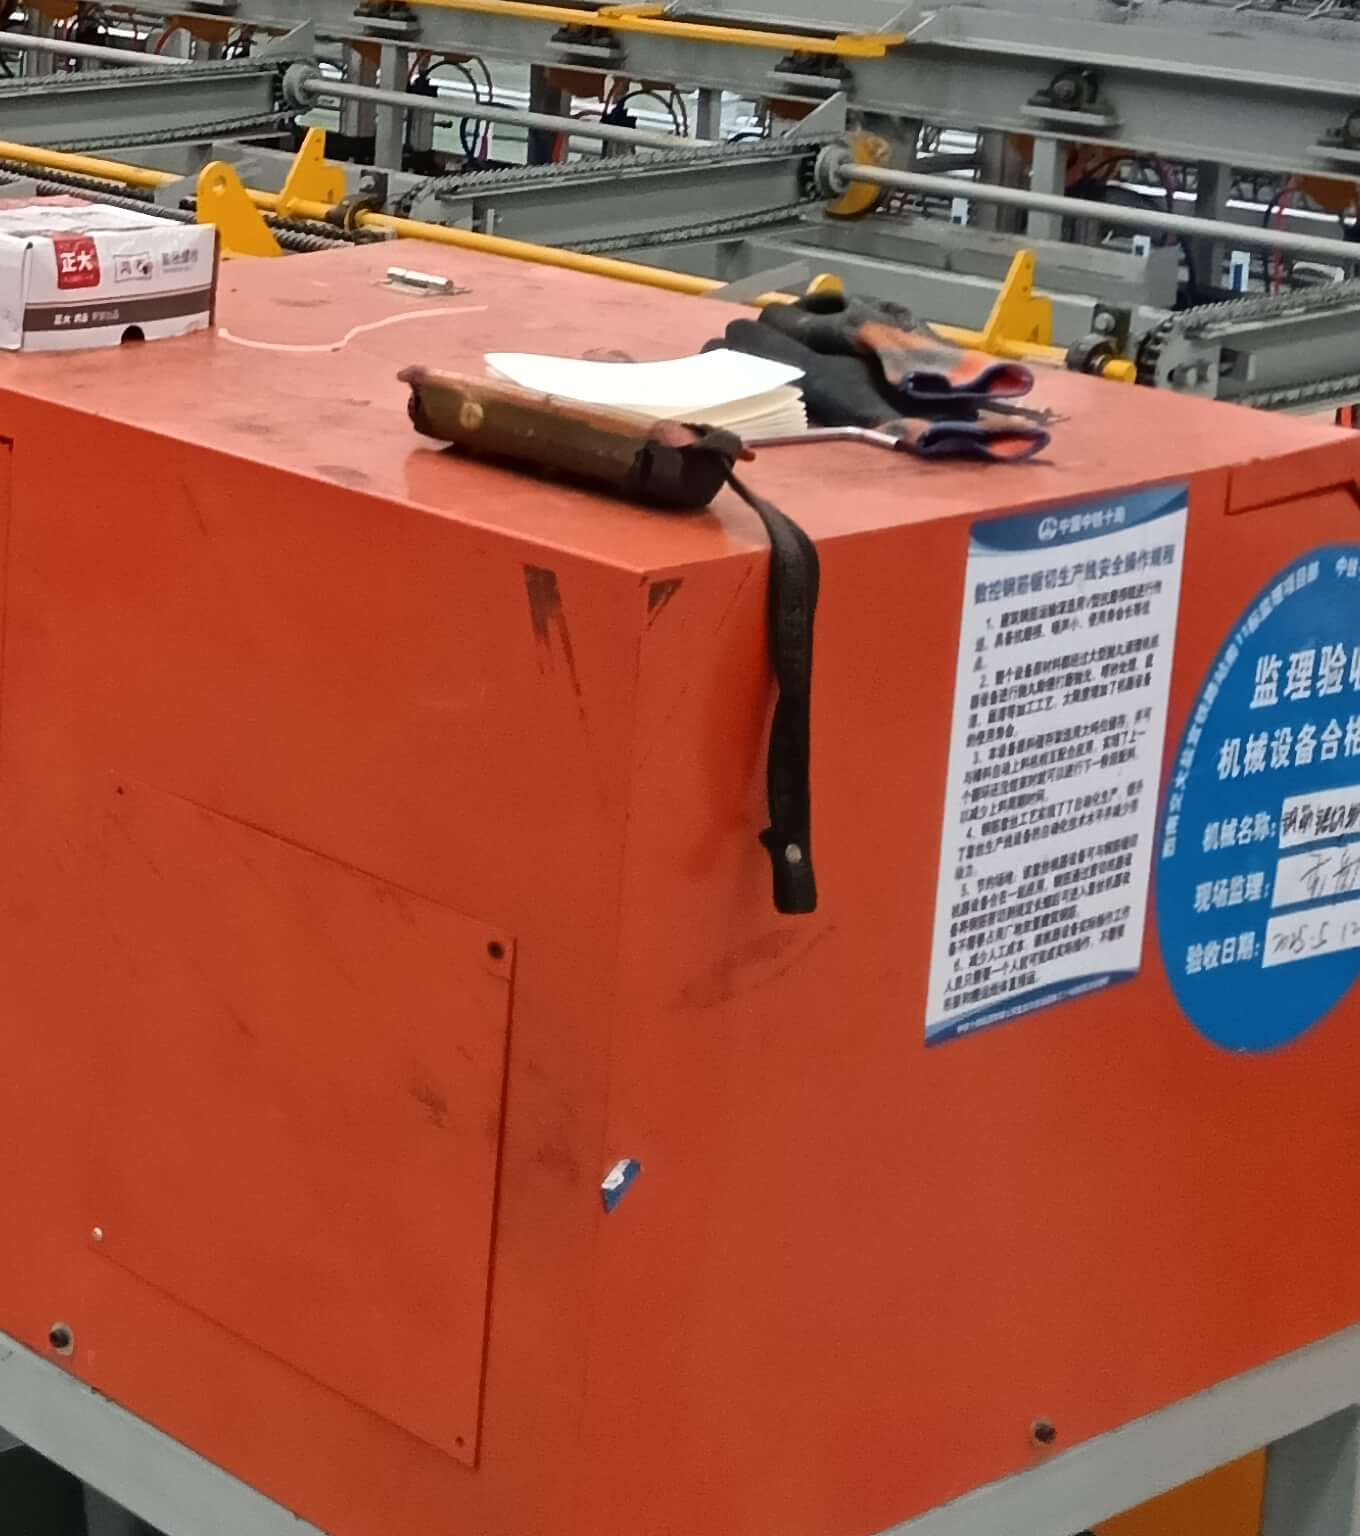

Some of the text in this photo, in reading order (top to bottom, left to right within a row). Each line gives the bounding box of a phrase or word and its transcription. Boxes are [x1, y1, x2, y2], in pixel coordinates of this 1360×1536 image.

[60, 250, 94, 273] 正大
[1057, 510, 1126, 536] 中国中铁十局
[1216, 716, 1360, 780] 机械设备合格
[1184, 931, 1261, 976] 验收日期：
